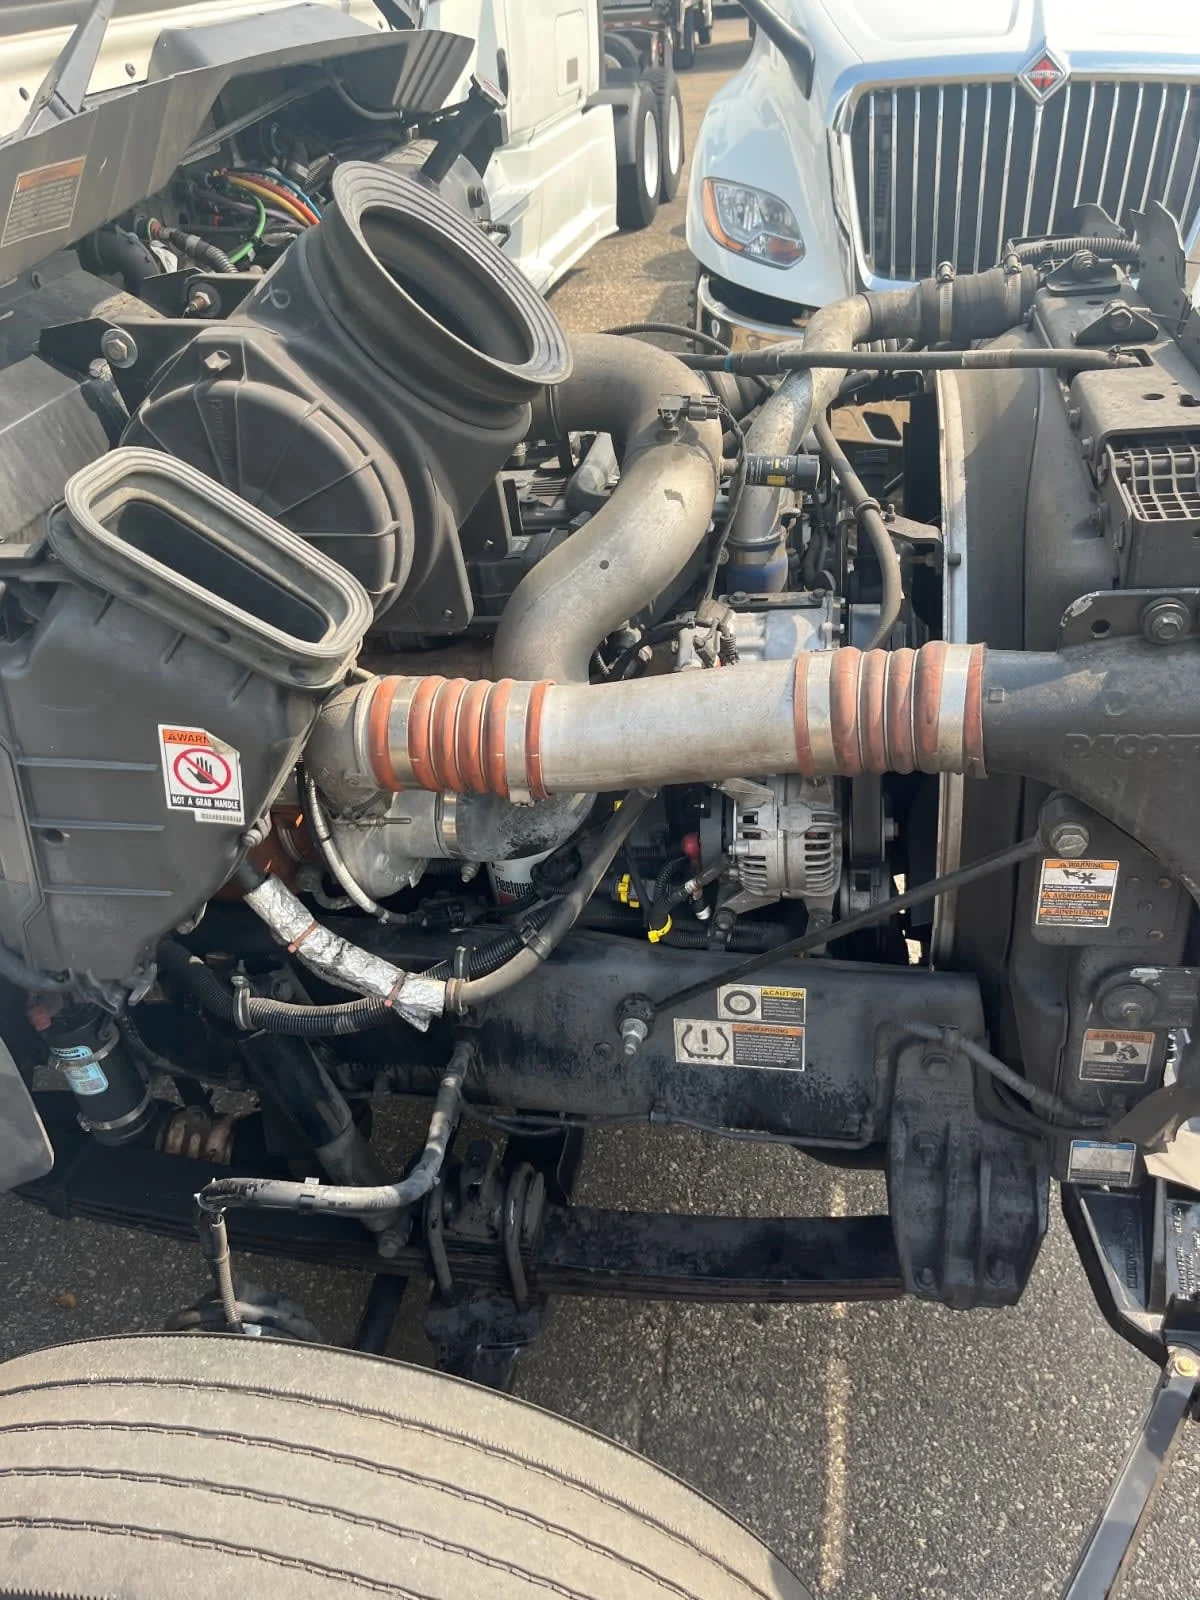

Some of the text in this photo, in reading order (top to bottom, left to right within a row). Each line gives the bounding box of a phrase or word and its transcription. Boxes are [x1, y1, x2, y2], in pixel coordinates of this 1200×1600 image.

[176, 732, 210, 744] WARN
[172, 796, 239, 809] NOT A GRAB HANDLE
